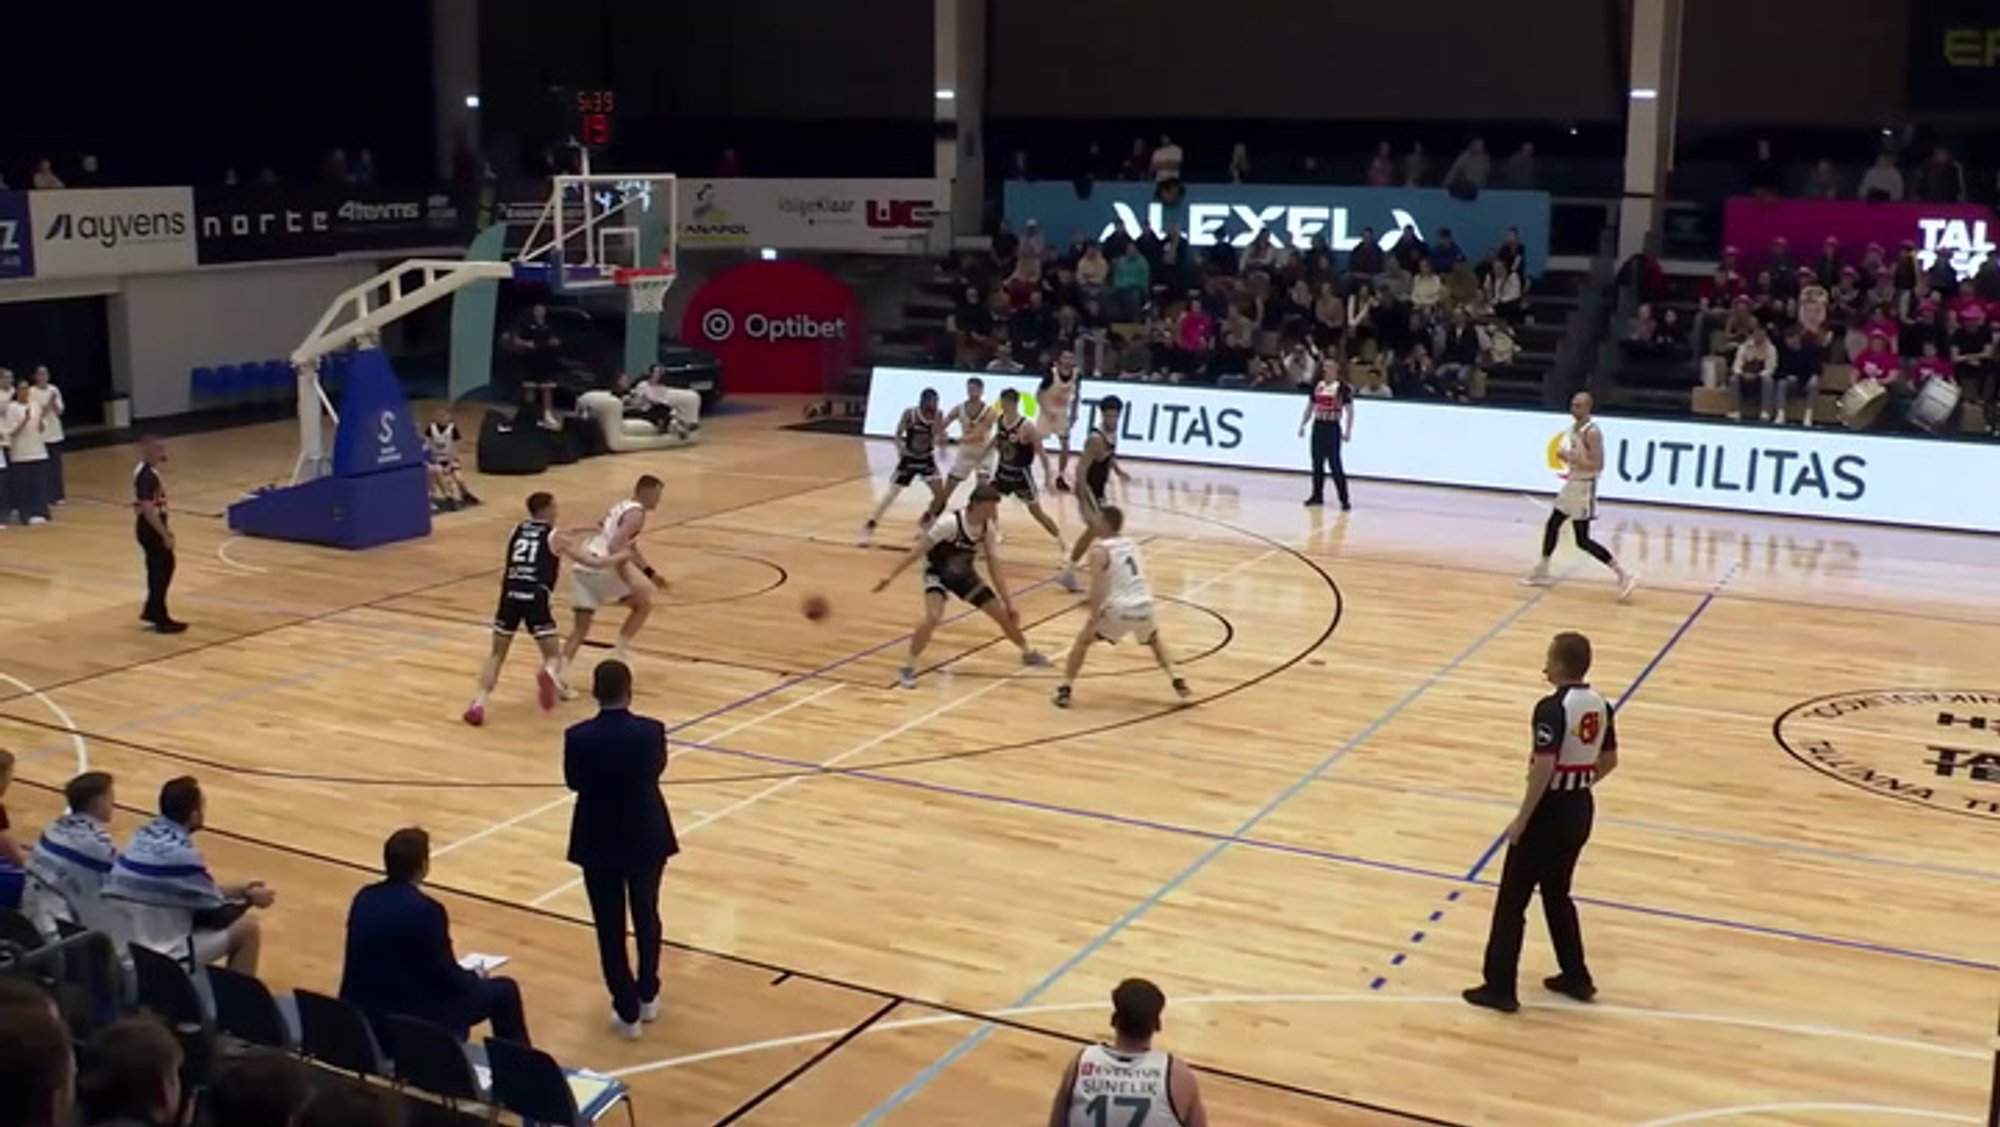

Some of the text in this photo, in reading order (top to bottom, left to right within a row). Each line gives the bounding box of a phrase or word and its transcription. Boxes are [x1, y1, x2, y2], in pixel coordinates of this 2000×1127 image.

[78, 211, 186, 248] ayvens
[202, 208, 330, 237] norte
[1099, 201, 1424, 250] ALEXELA
[1917, 218, 1997, 251] TAL
[744, 313, 847, 343] Optibet
[1617, 438, 1867, 501] UTILITAS
[511, 538, 539, 563] 21
[1124, 555, 1138, 576] 1
[1085, 1093, 1152, 1127] 17
